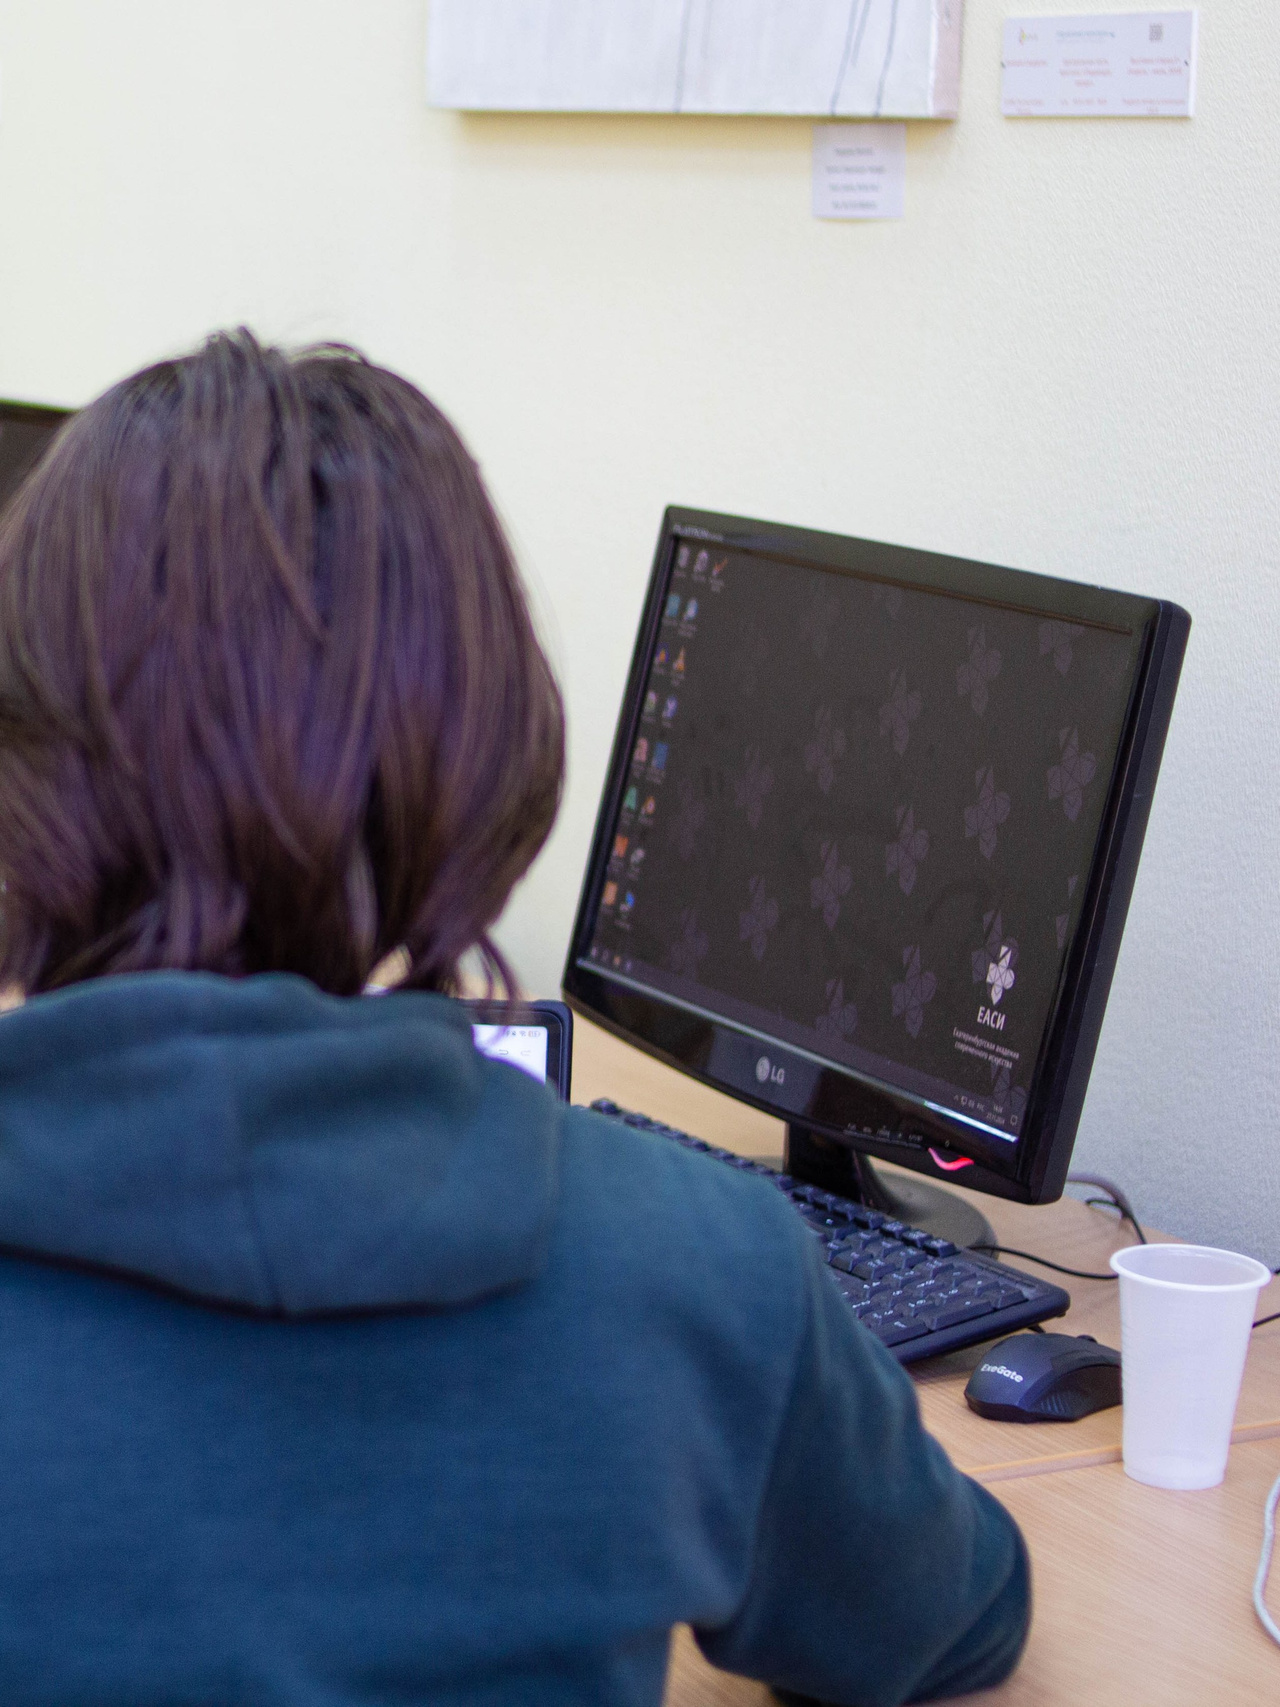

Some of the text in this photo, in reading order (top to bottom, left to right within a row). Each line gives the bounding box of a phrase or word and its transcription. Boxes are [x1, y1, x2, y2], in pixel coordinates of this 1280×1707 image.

[977, 1006, 1006, 1031] ЕАСИ
[770, 1065, 785, 1085] LG
[981, 1363, 1023, 1383] ExeGate
